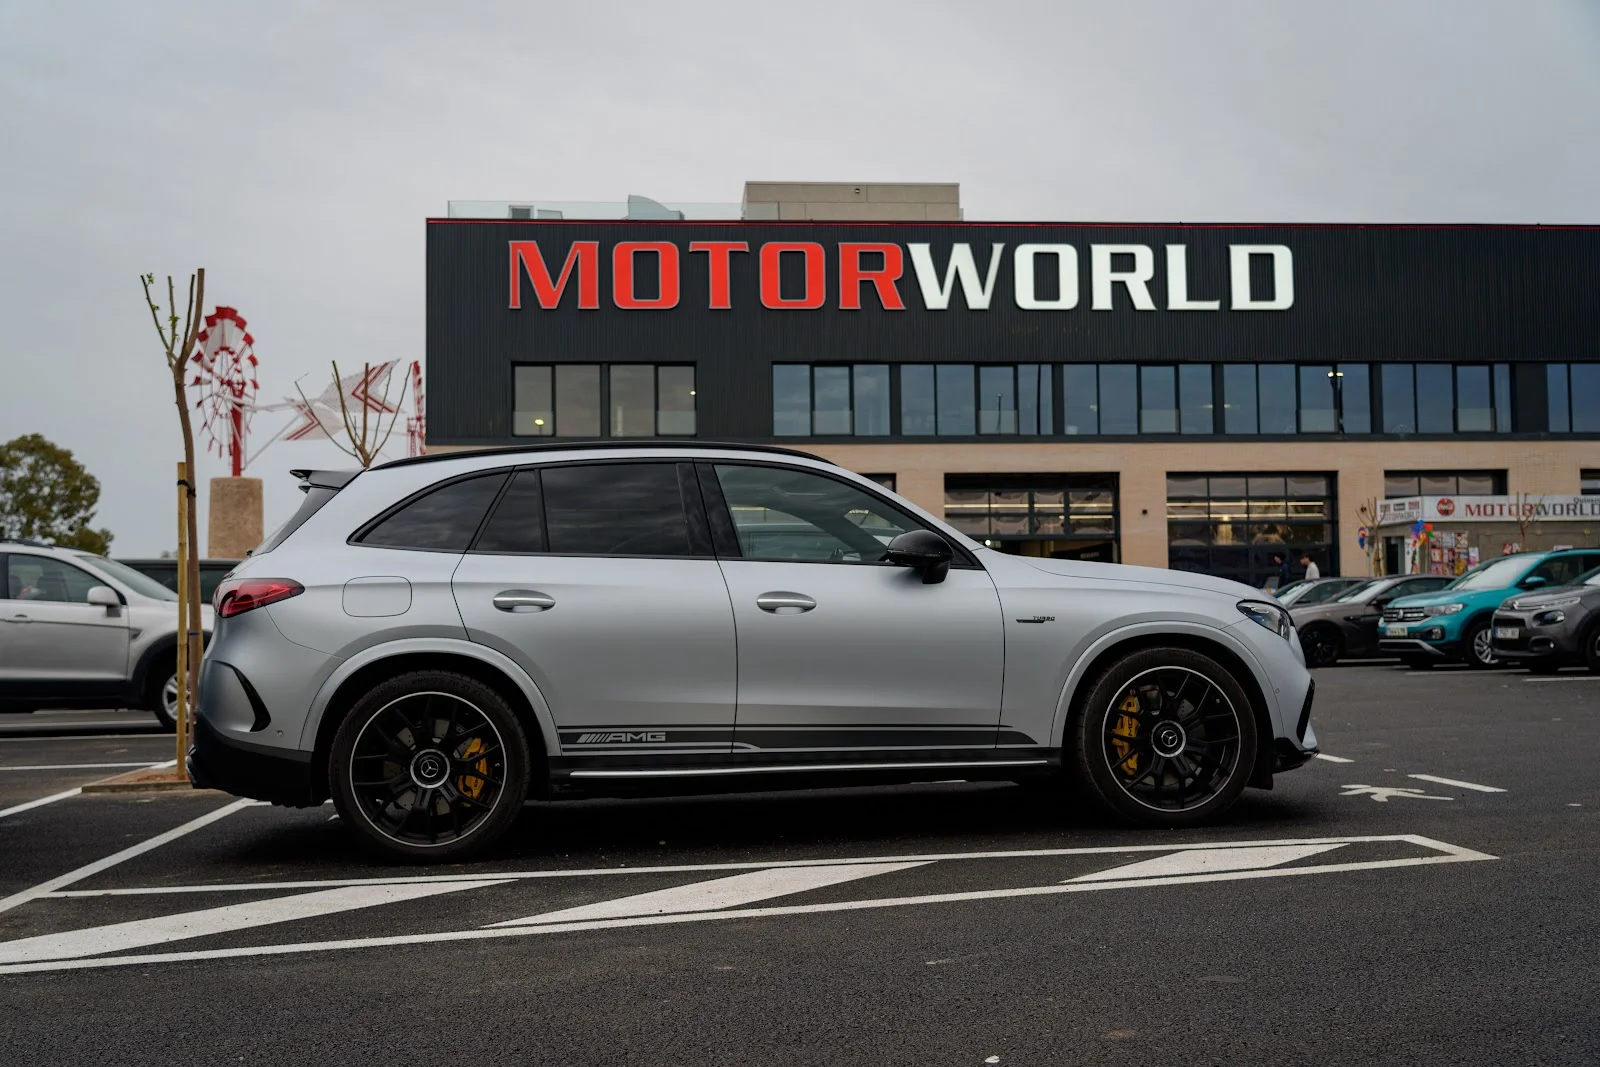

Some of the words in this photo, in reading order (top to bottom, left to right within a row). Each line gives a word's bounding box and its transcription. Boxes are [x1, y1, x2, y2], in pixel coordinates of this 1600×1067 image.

[508, 239, 1295, 312] MOTORWORLD
[1465, 503, 1600, 517] MOTORWORLD
[605, 732, 667, 743] AMG
